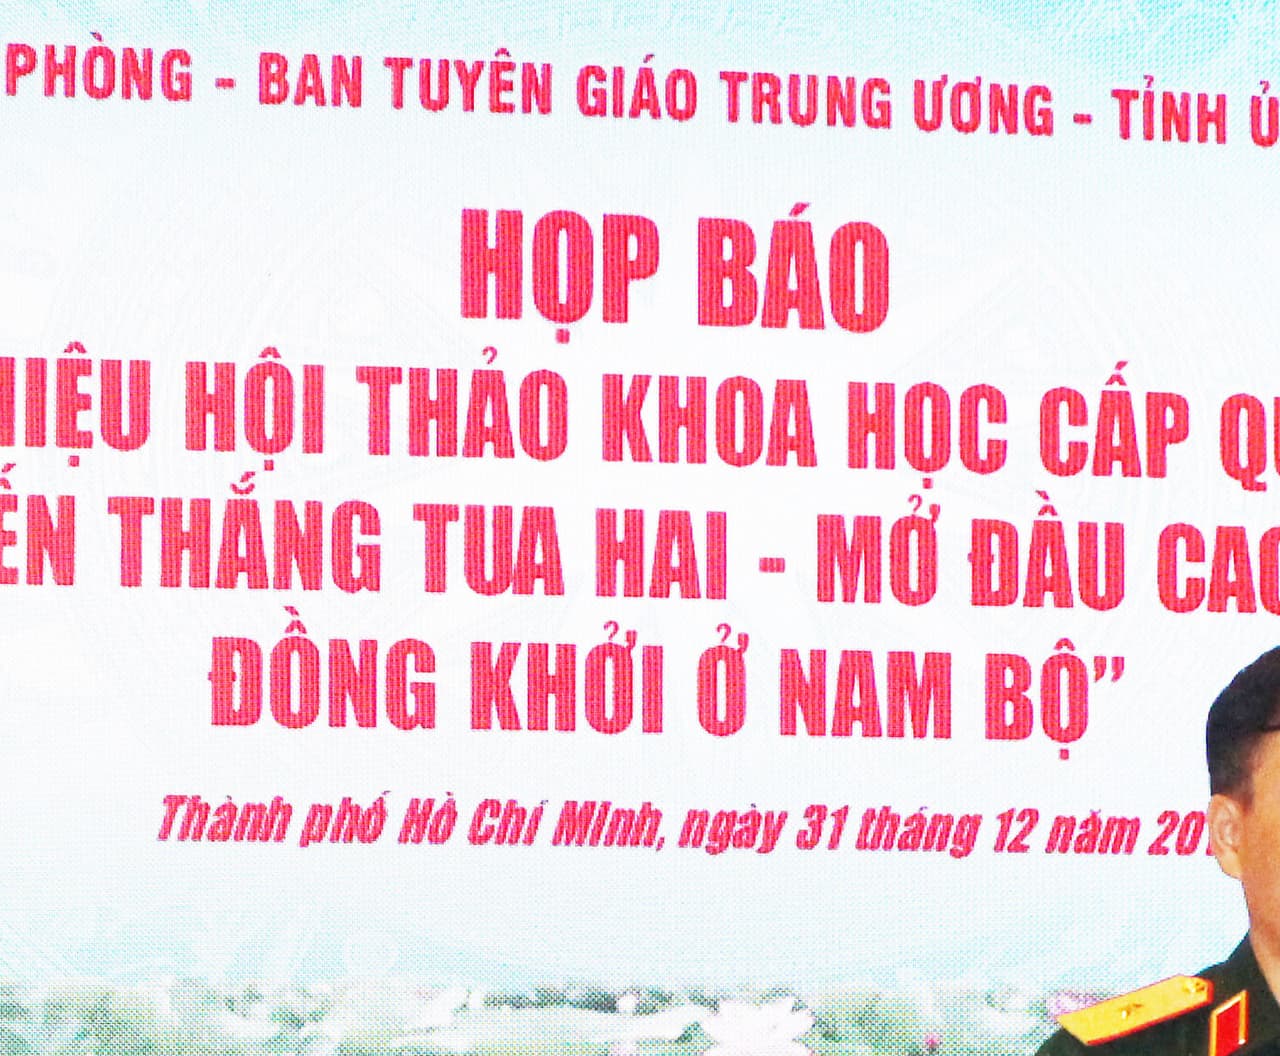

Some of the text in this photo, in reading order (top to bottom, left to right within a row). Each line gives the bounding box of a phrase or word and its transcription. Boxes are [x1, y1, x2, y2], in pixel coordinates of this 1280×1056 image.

[6, 33, 192, 102] PHÒNG
[259, 52, 362, 108] BAN
[384, 48, 552, 115] TUYÊN
[576, 54, 697, 121] GIÁO
[720, 71, 892, 129] TRUNG
[914, 74, 1054, 136] ƯƠNG
[1111, 75, 1227, 144] TỈNH
[461, 202, 889, 344] HỌP BÁO
[186, 346, 324, 480] HỘI
[356, 346, 568, 462] THẢO
[602, 373, 817, 468] KHOA
[848, 381, 1008, 489] HỌC
[1040, 361, 1189, 478] CẤP
[107, 477, 381, 594] THẮNG
[413, 503, 565, 596] TUA
[596, 508, 727, 600] HAI
[817, 494, 941, 607] MỞ
[968, 490, 1125, 612] ĐẦU
[208, 606, 1125, 760] ĐỒNG KHỞI Ở NAM BỘ”
[156, 793, 293, 842] Thành
[300, 790, 390, 847] phố
[399, 791, 456, 844] Hồ
[467, 798, 548, 846] Chí
[552, 800, 666, 851] Minh,
[677, 802, 788, 855] ngày
[796, 803, 850, 851] 31
[855, 805, 983, 859] tháng
[994, 807, 1039, 854] 12
[1045, 809, 1140, 855] năm
